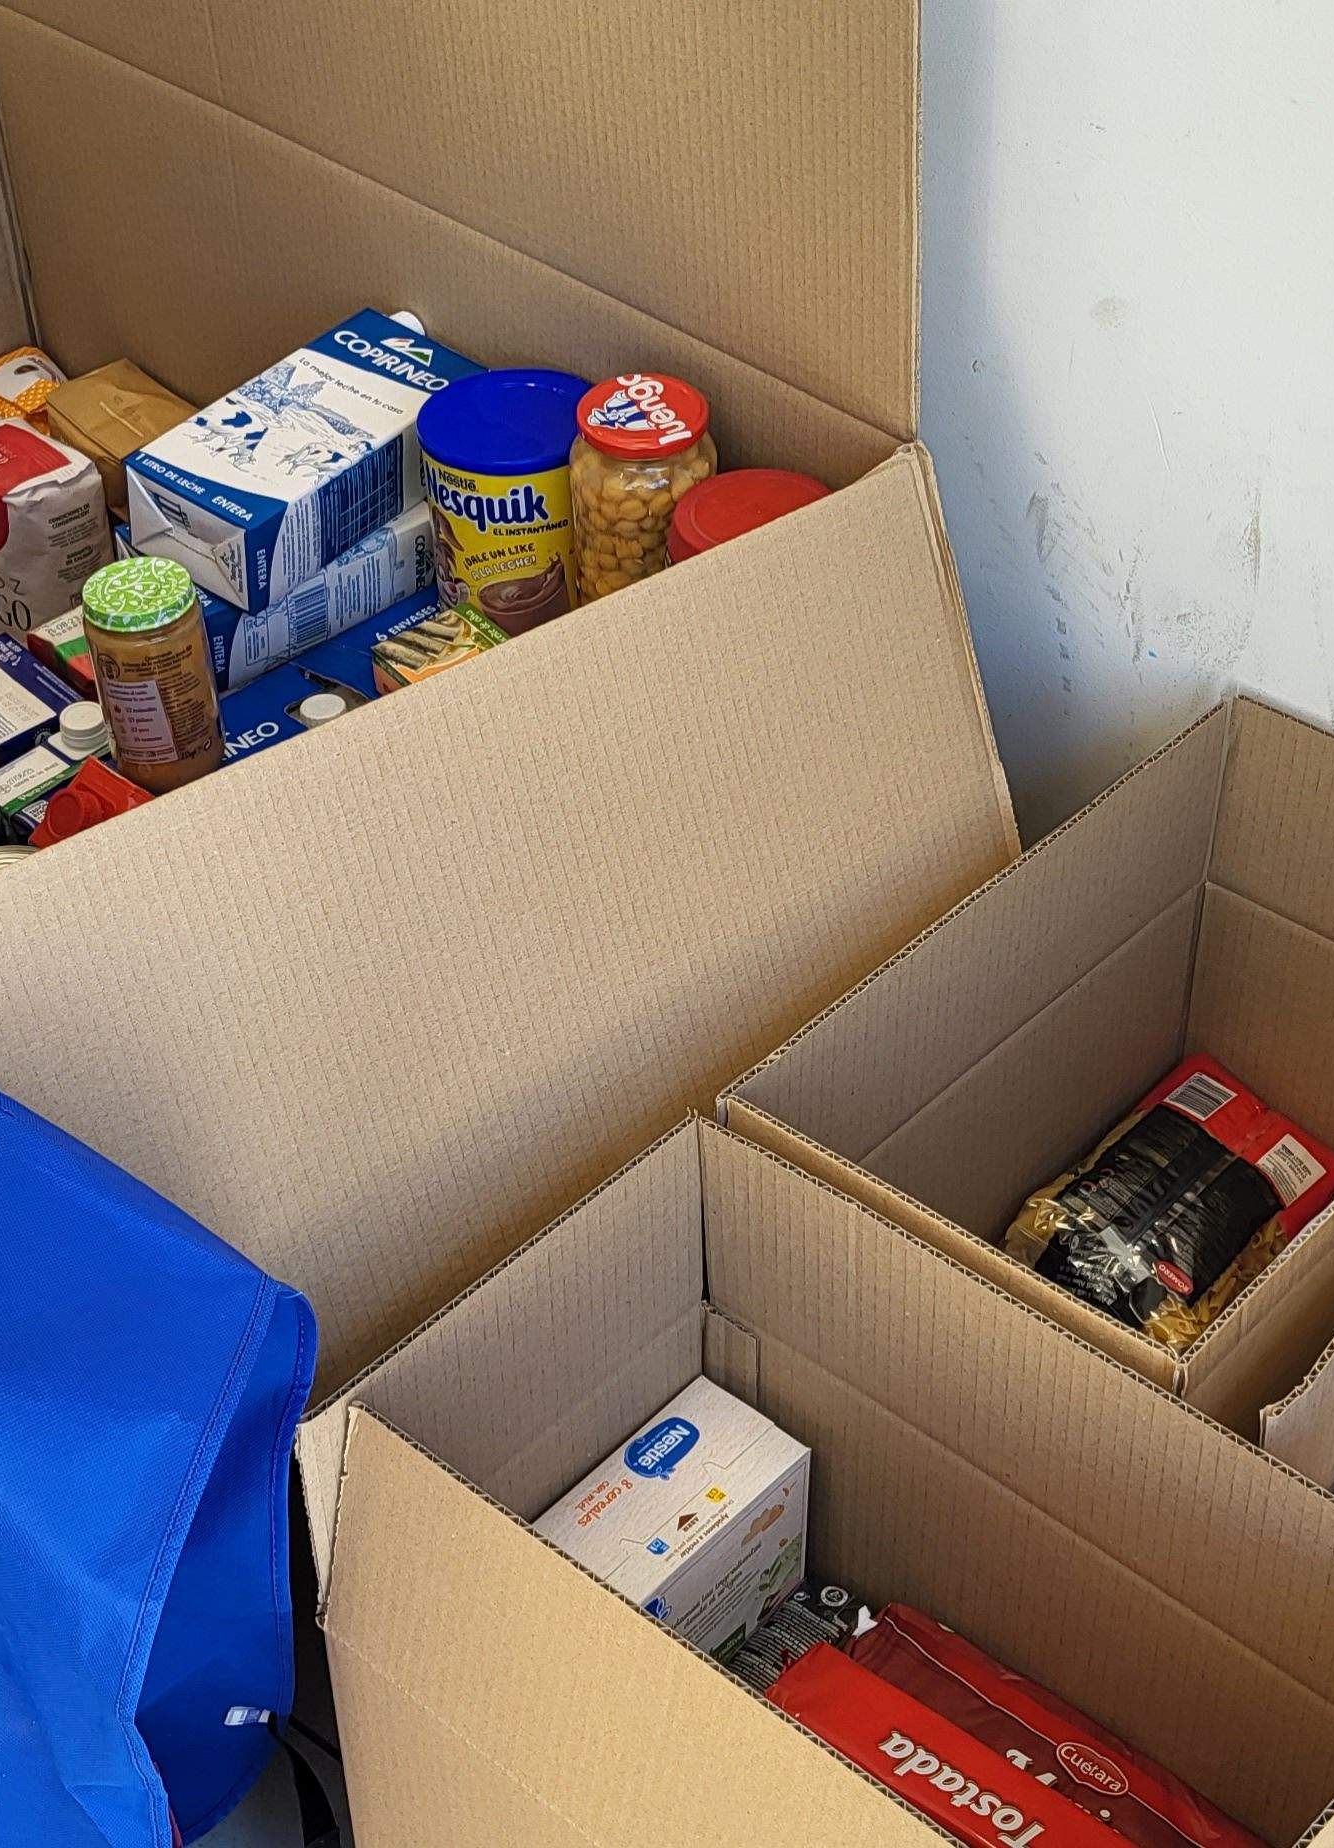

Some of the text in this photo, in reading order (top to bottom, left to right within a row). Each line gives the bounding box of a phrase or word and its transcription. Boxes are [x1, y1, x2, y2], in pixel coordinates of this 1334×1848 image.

[334, 331, 449, 390] COPIRINEO
[310, 364, 335, 383] mejor
[335, 379, 360, 394] leche
[360, 392, 372, 402] en
[382, 403, 403, 415] casa
[142, 458, 166, 474] LITRO
[165, 470, 179, 480] DE
[177, 477, 206, 495] LECHE
[212, 495, 254, 522] ENTERA
[426, 462, 549, 532] Nesquik
[489, 548, 506, 559] UN
[508, 543, 536, 555] LIKE
[493, 528, 504, 536] EL
[256, 549, 267, 590] ENTERA
[375, 605, 437, 642] 6 ENVASES
[213, 635, 225, 673] ENTERA
[575, 1480, 610, 1512] con miel
[577, 1479, 633, 1527] 8 cereales
[878, 1730, 1046, 1848] Tostada
[1060, 1744, 1122, 1793] Cuétara
